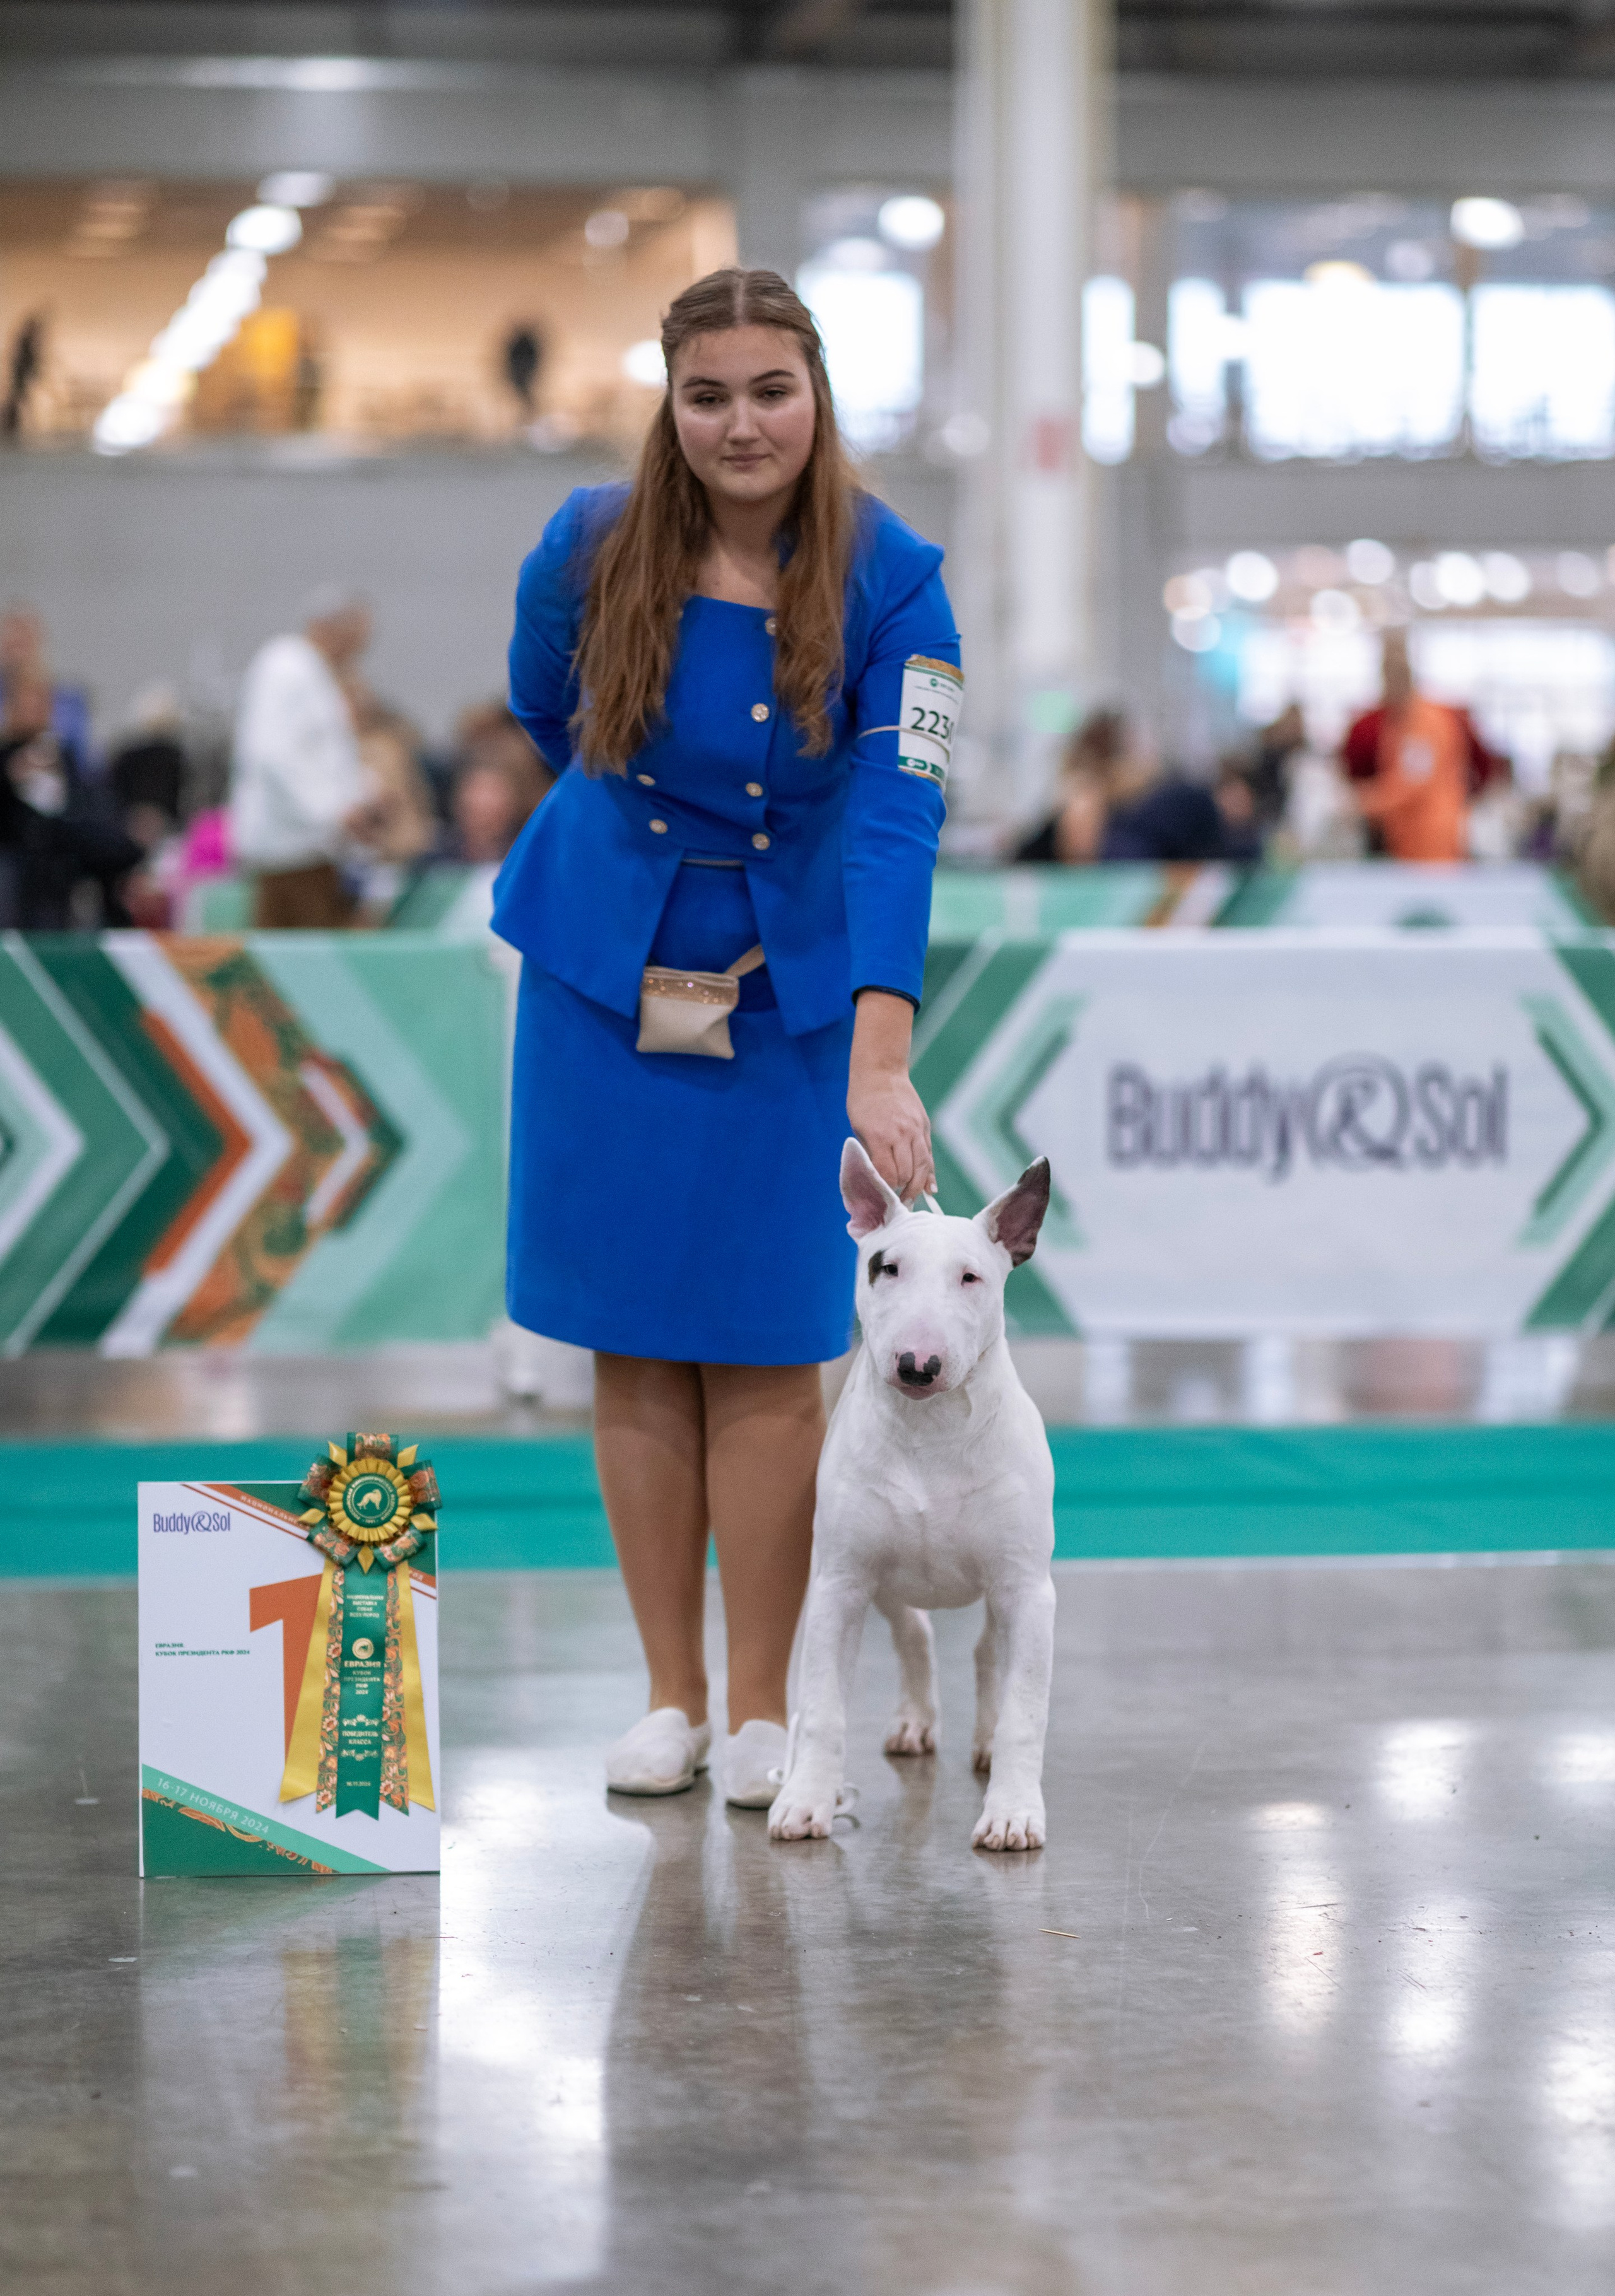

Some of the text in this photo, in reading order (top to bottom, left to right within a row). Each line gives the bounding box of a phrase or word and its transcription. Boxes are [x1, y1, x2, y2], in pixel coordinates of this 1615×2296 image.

[911, 706, 954, 744] 223
[158, 1778, 269, 1834] 16-17 НОЯБРЯ 2024
